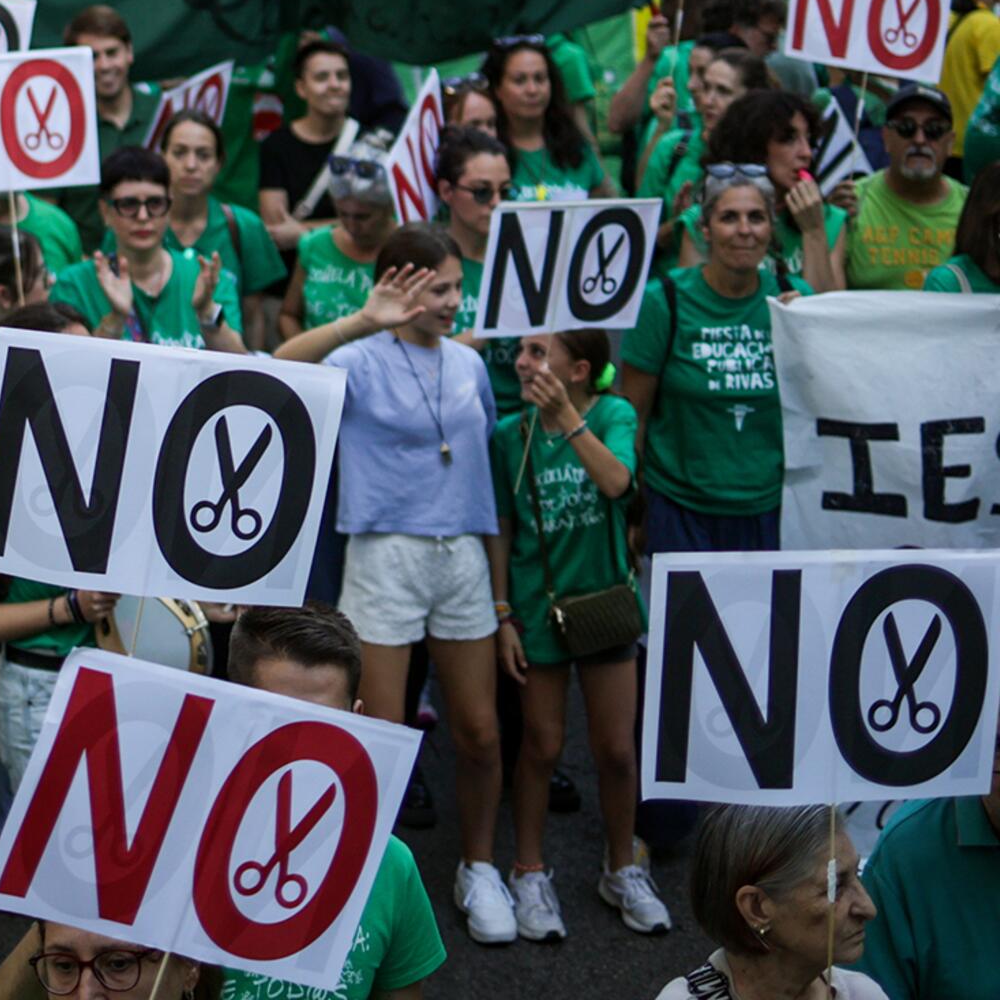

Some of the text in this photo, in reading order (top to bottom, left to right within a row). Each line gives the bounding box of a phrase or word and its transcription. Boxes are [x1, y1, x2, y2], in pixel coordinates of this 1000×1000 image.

[484, 208, 647, 329] NO
[726, 371, 774, 391] RIVAS
[816, 416, 1000, 524] IE
[655, 564, 988, 789] NO
